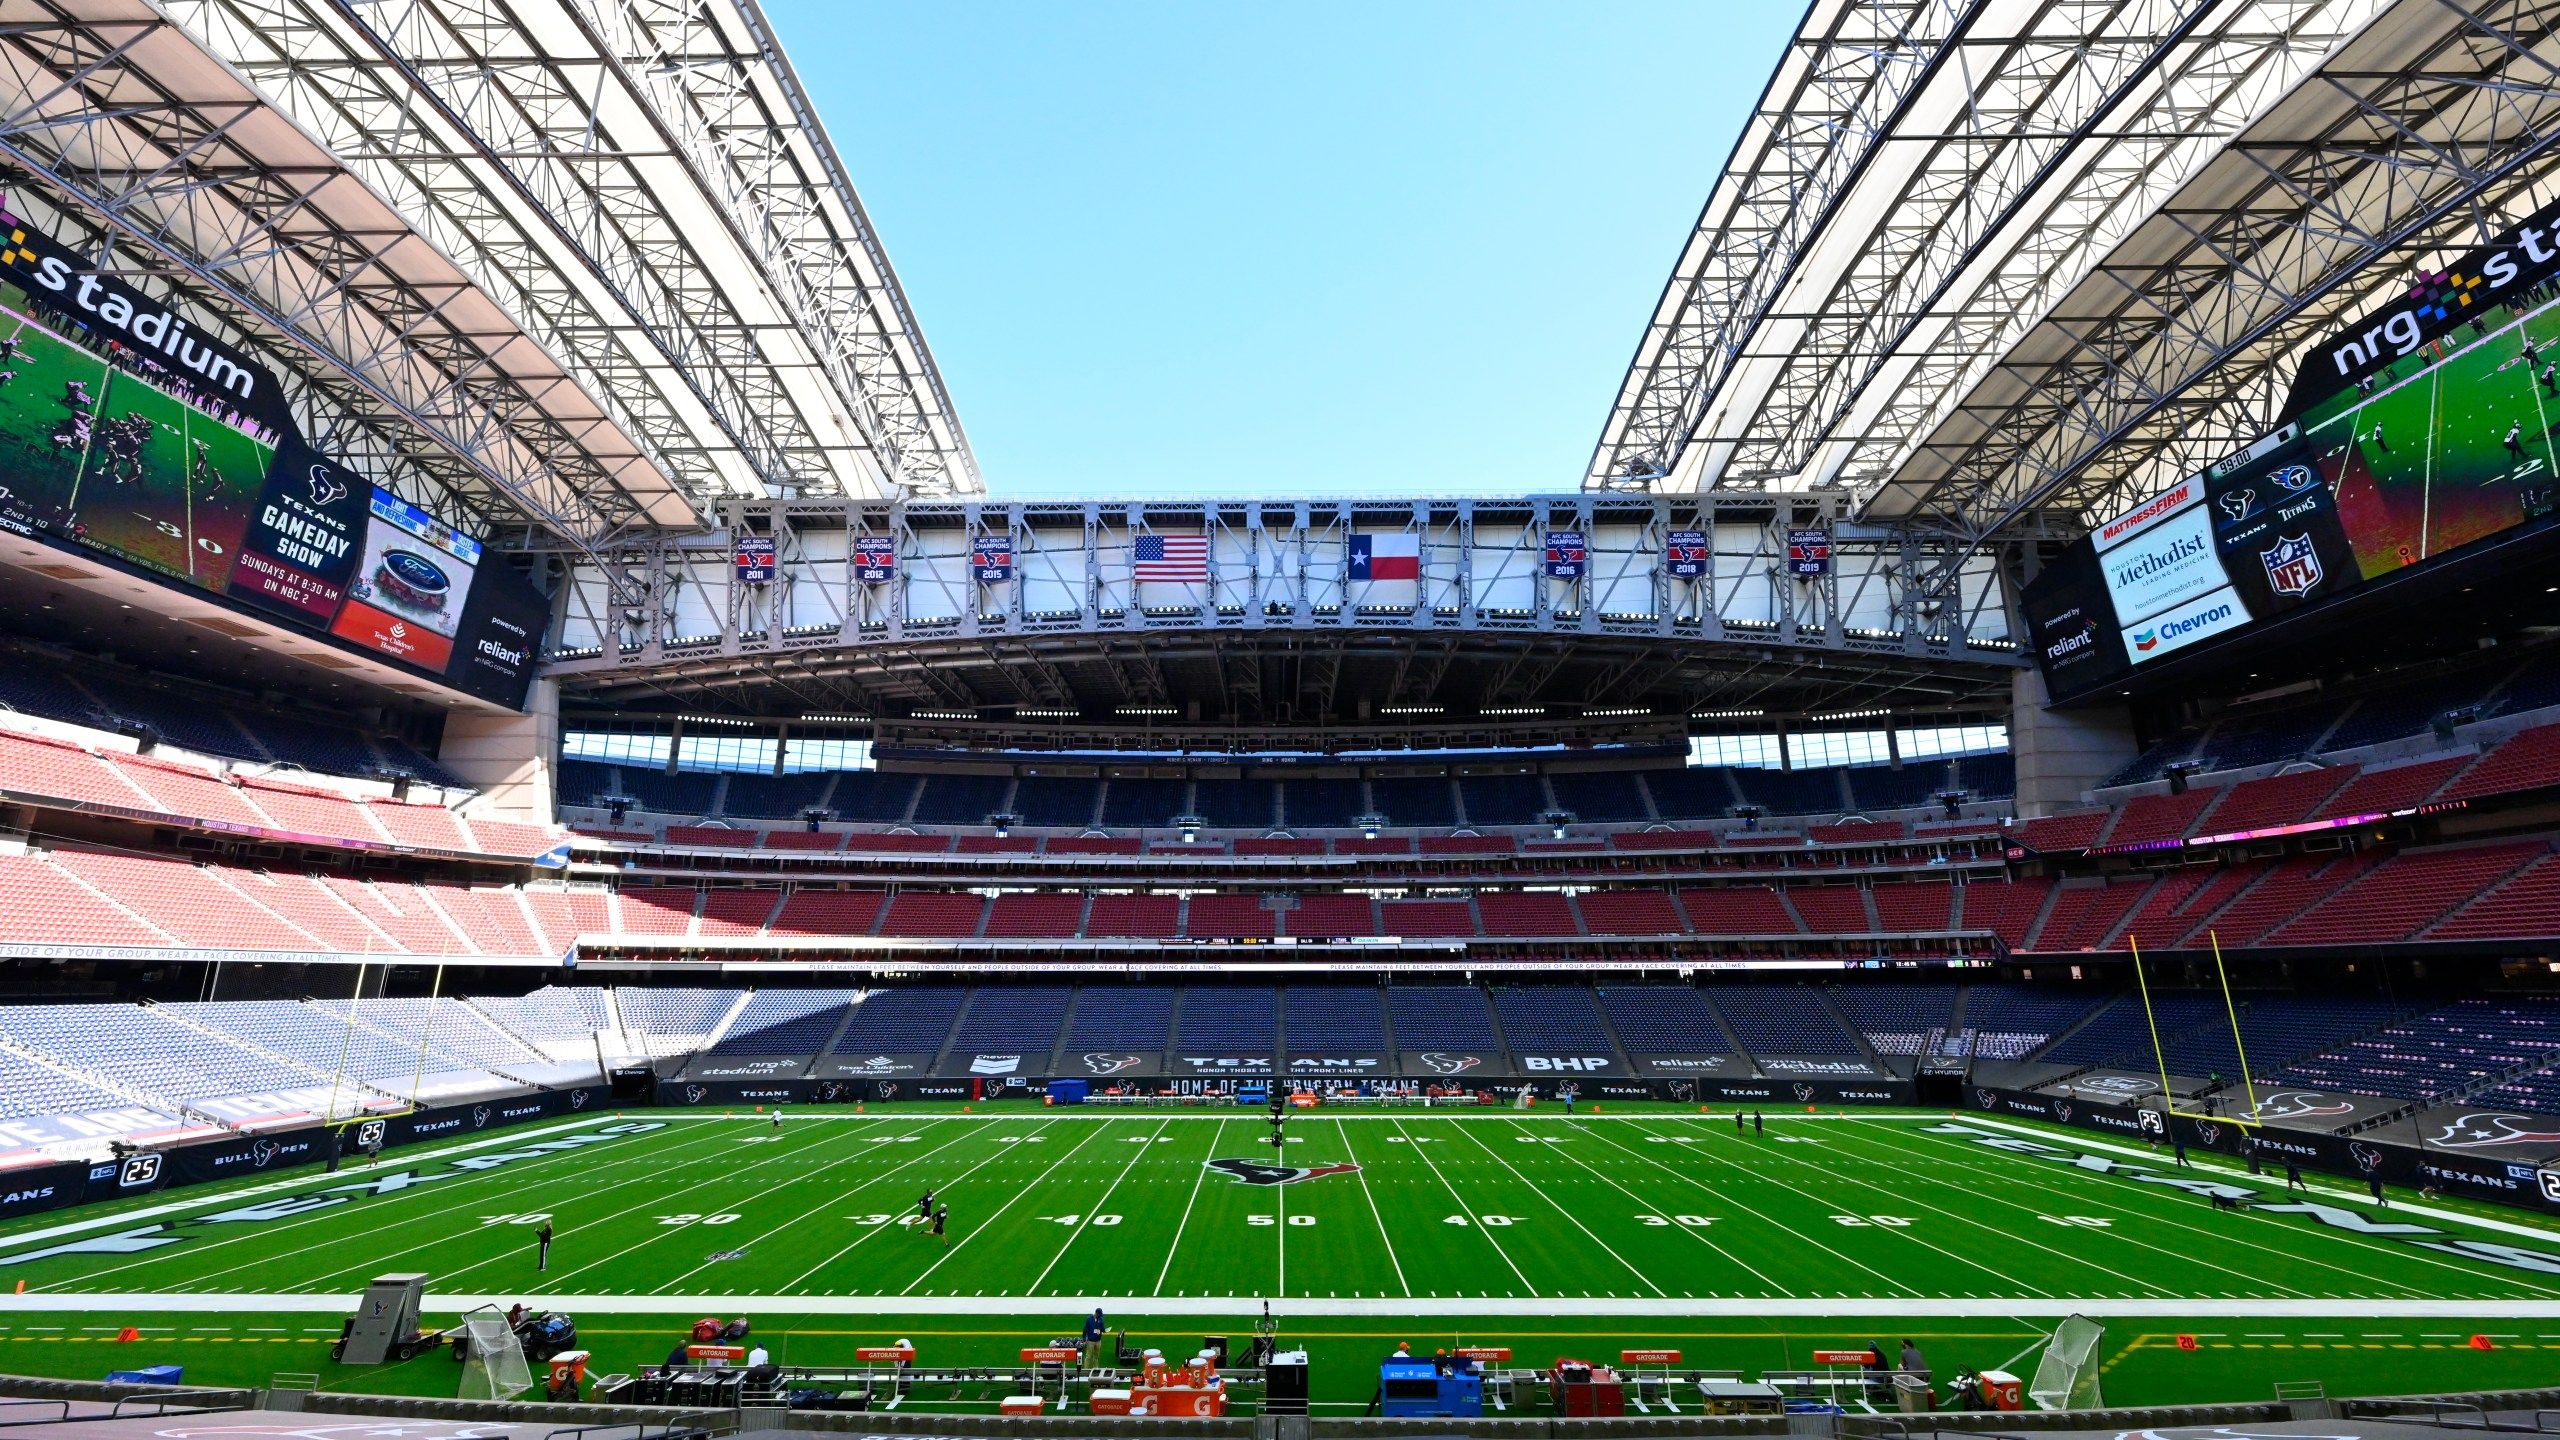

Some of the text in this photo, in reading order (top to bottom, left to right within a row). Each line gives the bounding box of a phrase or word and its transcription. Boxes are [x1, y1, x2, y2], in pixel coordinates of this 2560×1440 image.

[33, 255, 255, 399] stadium
[2332, 310, 2422, 376] nrg
[2220, 450, 2251, 474] 99:00
[282, 494, 346, 531] TEXANS
[372, 502, 385, 515] AND
[391, 499, 408, 515] LIGHT
[2103, 486, 2189, 540] MATTRESSFIRM
[2278, 496, 2316, 522] TITANS
[3, 507, 48, 529] 2ND 10
[261, 505, 351, 558] GAMEDAY
[2226, 523, 2267, 544] TEXANS
[277, 538, 324, 568] SHOW
[1676, 564, 1697, 573] 2018
[1799, 563, 1820, 571] 2019
[2111, 553, 2145, 573] HOUSTON
[2116, 534, 2206, 589] Methodist
[746, 570, 763, 579] 2011
[864, 570, 884, 579] 2012
[982, 570, 1002, 579] 2015
[1555, 566, 1575, 575] 2016
[2142, 553, 2210, 587] LEADING MEDICINE
[2273, 558, 2317, 590] NFL
[241, 554, 338, 601] SUNDAYS AT 8:30 AM
[264, 579, 309, 604] ON NBC 2
[2134, 576, 2206, 610] houstonmethodist.org
[2044, 607, 2080, 629] powered by
[2160, 603, 2232, 639] Chevron
[491, 616, 527, 637] powered by
[374, 630, 415, 651] Texas Children's
[2047, 630, 2091, 658] reliant
[380, 642, 403, 655] Hospital
[478, 639, 521, 666] reliant
[494, 664, 517, 677] company
[201, 820, 227, 830] HOUSTON
[2189, 836, 2213, 845] HOUSTON
[44, 947, 64, 956] OF
[67, 948, 104, 957] YOUR
[107, 949, 152, 958] GROUP.
[157, 950, 189, 959] WEAR
[203, 952, 228, 960] FACE
[232, 952, 283, 960] COVERING
[286, 953, 297, 961] AT
[316, 954, 344, 962] TIMES.
[748, 1061, 779, 1069] nrg
[1524, 1057, 1609, 1071] BHP
[1651, 1059, 1717, 1067] reliant
[1766, 1060, 1870, 1071] Methodist
[702, 1067, 774, 1075] stadium
[1171, 1080, 1238, 1094] HOME OF
[1494, 1085, 1539, 1093] TEXANS
[1720, 1088, 1770, 1096] TEXANS
[1839, 1091, 1891, 1099] TEXANS
[503, 1105, 541, 1117] TEXANS
[2008, 1101, 2045, 1113] TEXANS
[414, 1119, 460, 1133] TEXANS
[2092, 1114, 2139, 1128] TEXANS
[362, 1123, 382, 1141] 25
[2252, 1138, 2317, 1155] TEXANS
[215, 1143, 309, 1165] BULL PEN
[101, 1166, 116, 1176] NFL
[126, 1158, 155, 1182] 25
[2425, 1166, 2518, 1189] TEXANS
[657, 1213, 742, 1225] 20
[1054, 1214, 1124, 1226] 40
[1247, 1214, 1316, 1226] 50
[1442, 1214, 1514, 1227] 40
[1633, 1215, 1713, 1227] 30
[2179, 1336, 2196, 1349] 20
[699, 1349, 729, 1357] GATORADE
[868, 1351, 900, 1359] GATORADE
[1466, 1351, 1498, 1359] GATORADE
[555, 1366, 568, 1381] G
[1150, 1368, 1159, 1378] G
[1193, 1369, 1201, 1378] G
[2004, 1387, 2019, 1404] G
[1097, 1403, 1124, 1411] GATORADE
[1141, 1394, 1158, 1415] G
[1193, 1394, 1211, 1415] G
